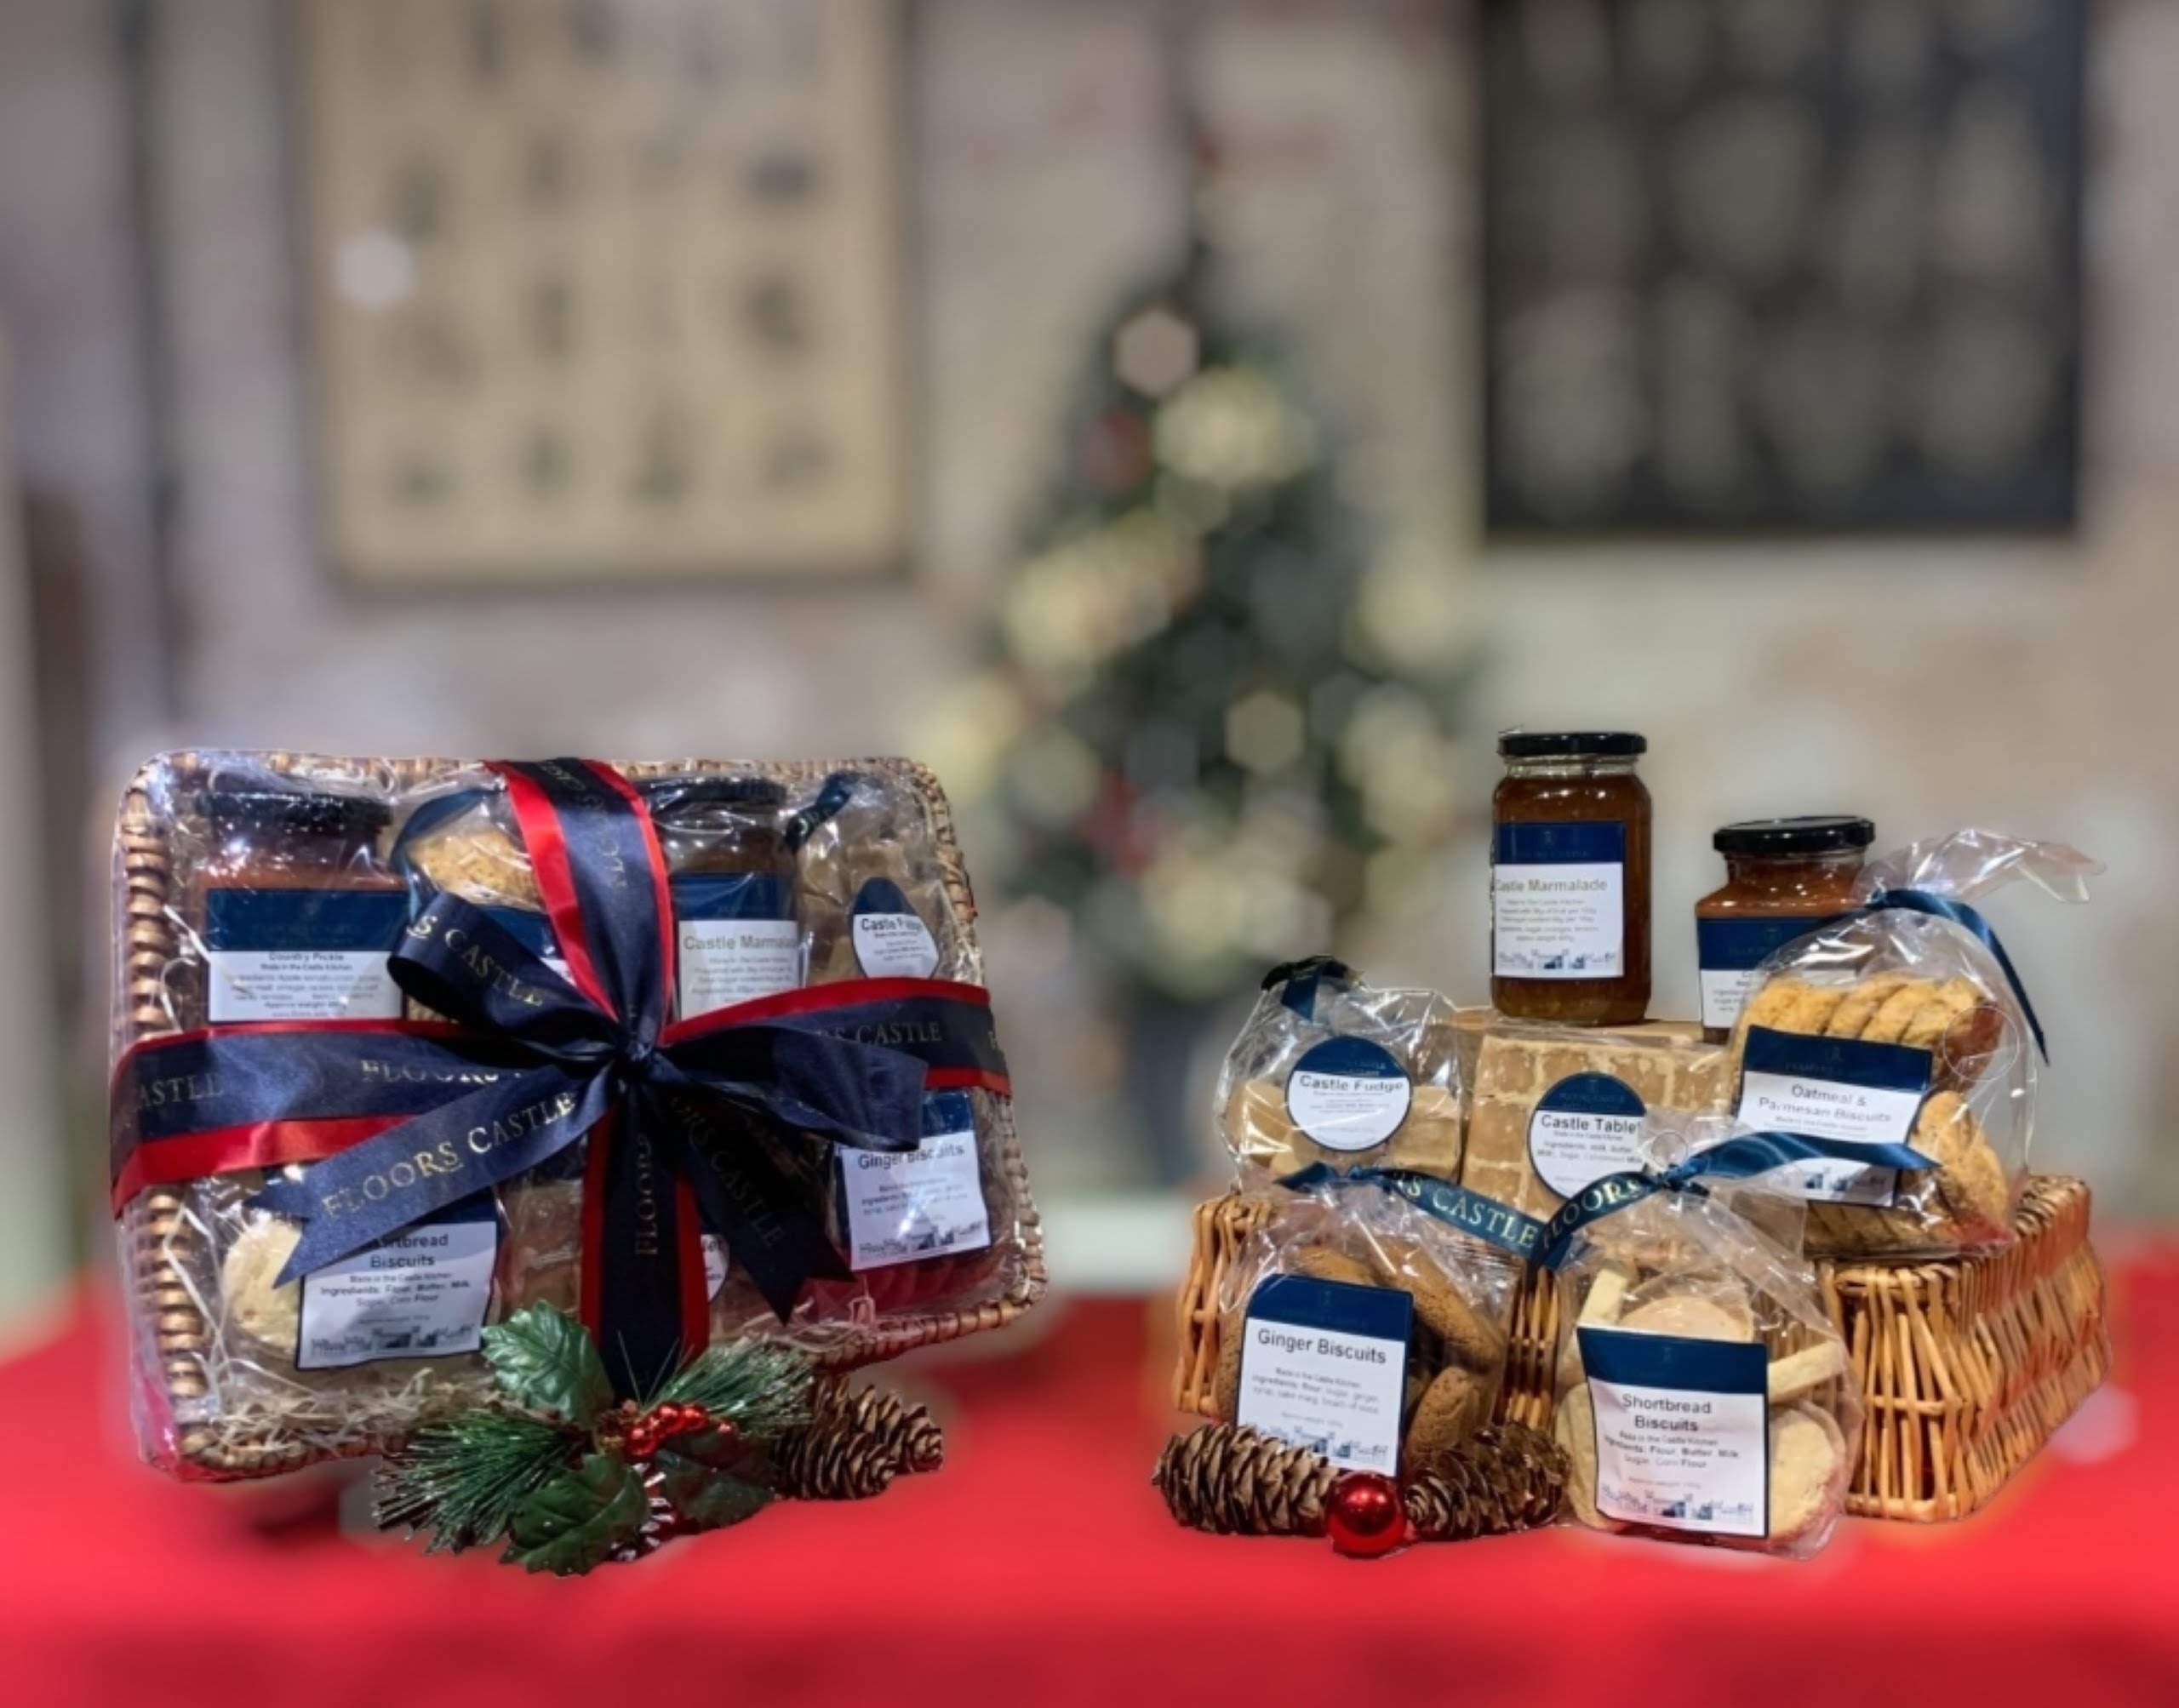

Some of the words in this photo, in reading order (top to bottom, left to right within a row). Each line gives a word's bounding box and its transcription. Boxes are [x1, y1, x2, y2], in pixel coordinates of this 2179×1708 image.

[1529, 879, 1608, 891] Marmalade
[683, 936, 736, 950] Castle
[855, 1022, 942, 1045] CASTLE
[140, 1073, 225, 1107] ASTLE
[1300, 1075, 1348, 1091] Castle
[1354, 1080, 1404, 1093] Fudge
[1792, 1084, 1852, 1105] Oatmeal
[1856, 1096, 1867, 1106] &
[1759, 1096, 1830, 1117] Parmesan
[1834, 1108, 1892, 1122] Biscuits
[1541, 1115, 1589, 1130] Castle
[322, 1141, 464, 1217] FLOORS
[468, 1091, 577, 1154] CASTLE
[1432, 1188, 1539, 1248] CASTLE
[370, 1255, 435, 1268] Biscuits
[1258, 1328, 1313, 1352] Ginger
[1318, 1339, 1387, 1363] Biscuits
[1622, 1394, 1713, 1414] Shortbread
[1635, 1415, 1699, 1431] Biscuits
